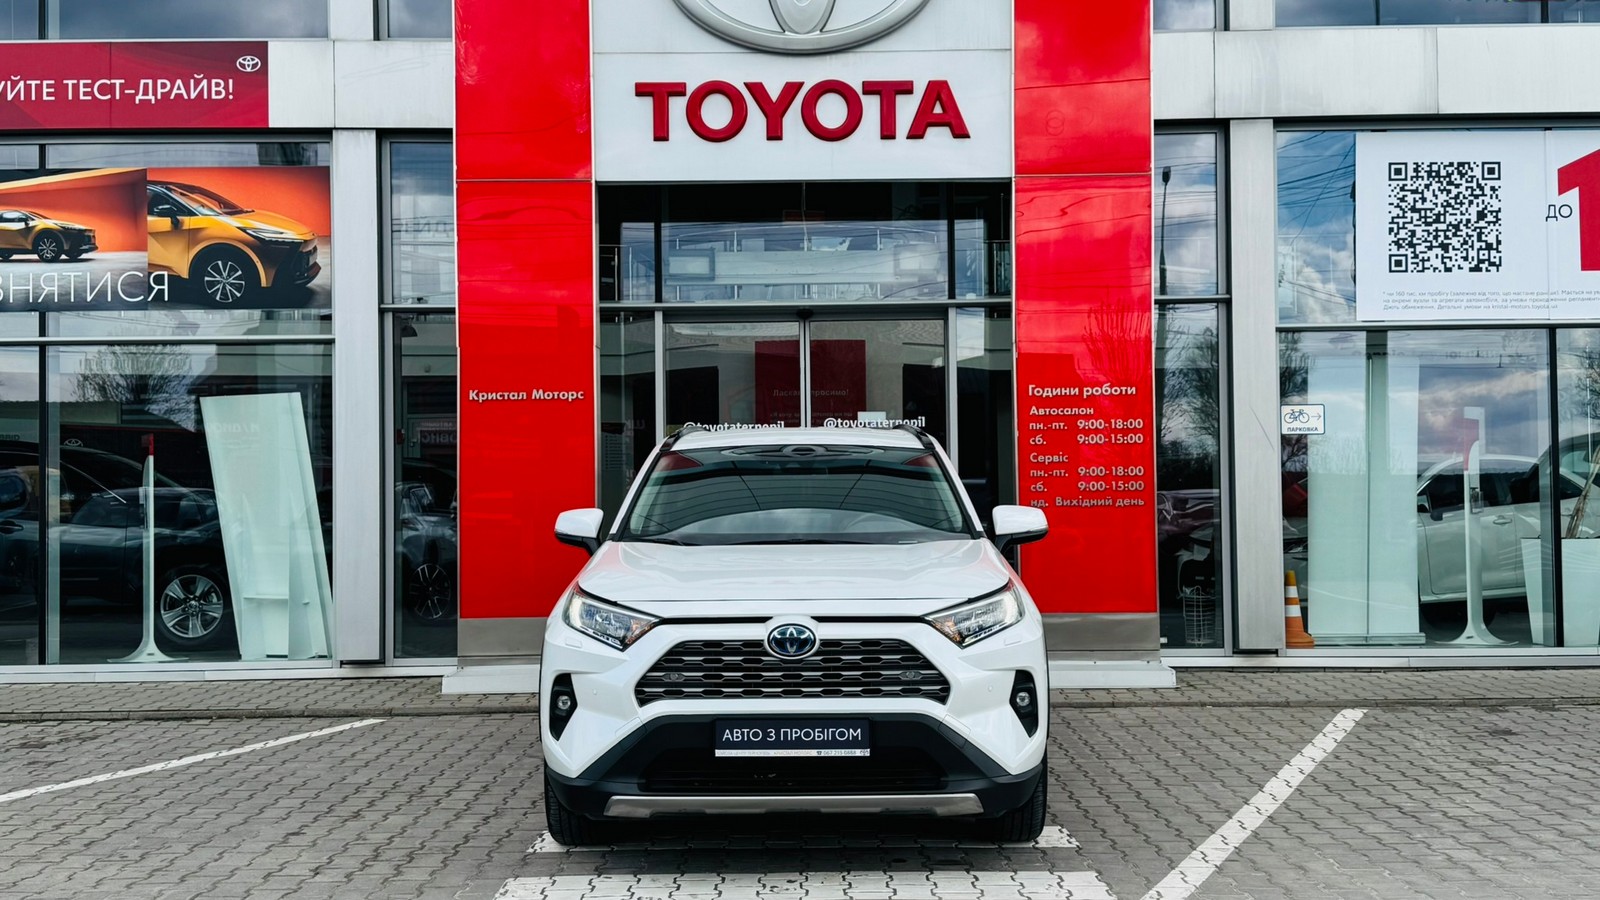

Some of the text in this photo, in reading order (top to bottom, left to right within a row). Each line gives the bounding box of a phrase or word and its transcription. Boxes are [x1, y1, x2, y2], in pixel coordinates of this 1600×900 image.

[63, 73, 234, 104] ТЕСТ-ДРАЙВ!
[635, 79, 971, 142] TOYOTA
[0, 271, 169, 303] НЯТИСЯ
[469, 388, 584, 403] Кристал Моторс
[1028, 382, 1136, 399] Години роботи
[1029, 405, 1094, 415] Автосалон
[1029, 418, 1144, 430] пн.-пт. 9:00-18:00
[1029, 433, 1144, 445] сб. 9:00-15:00
[1029, 451, 1069, 465] Сервіс
[1030, 465, 1144, 477] пн.-пт. 9:00-18:00
[1030, 480, 1145, 491] сб. 9:00-15:00
[1030, 495, 1145, 507] нд. Вихідний день
[722, 727, 862, 741] АВТО З ПРОБІГОМ
